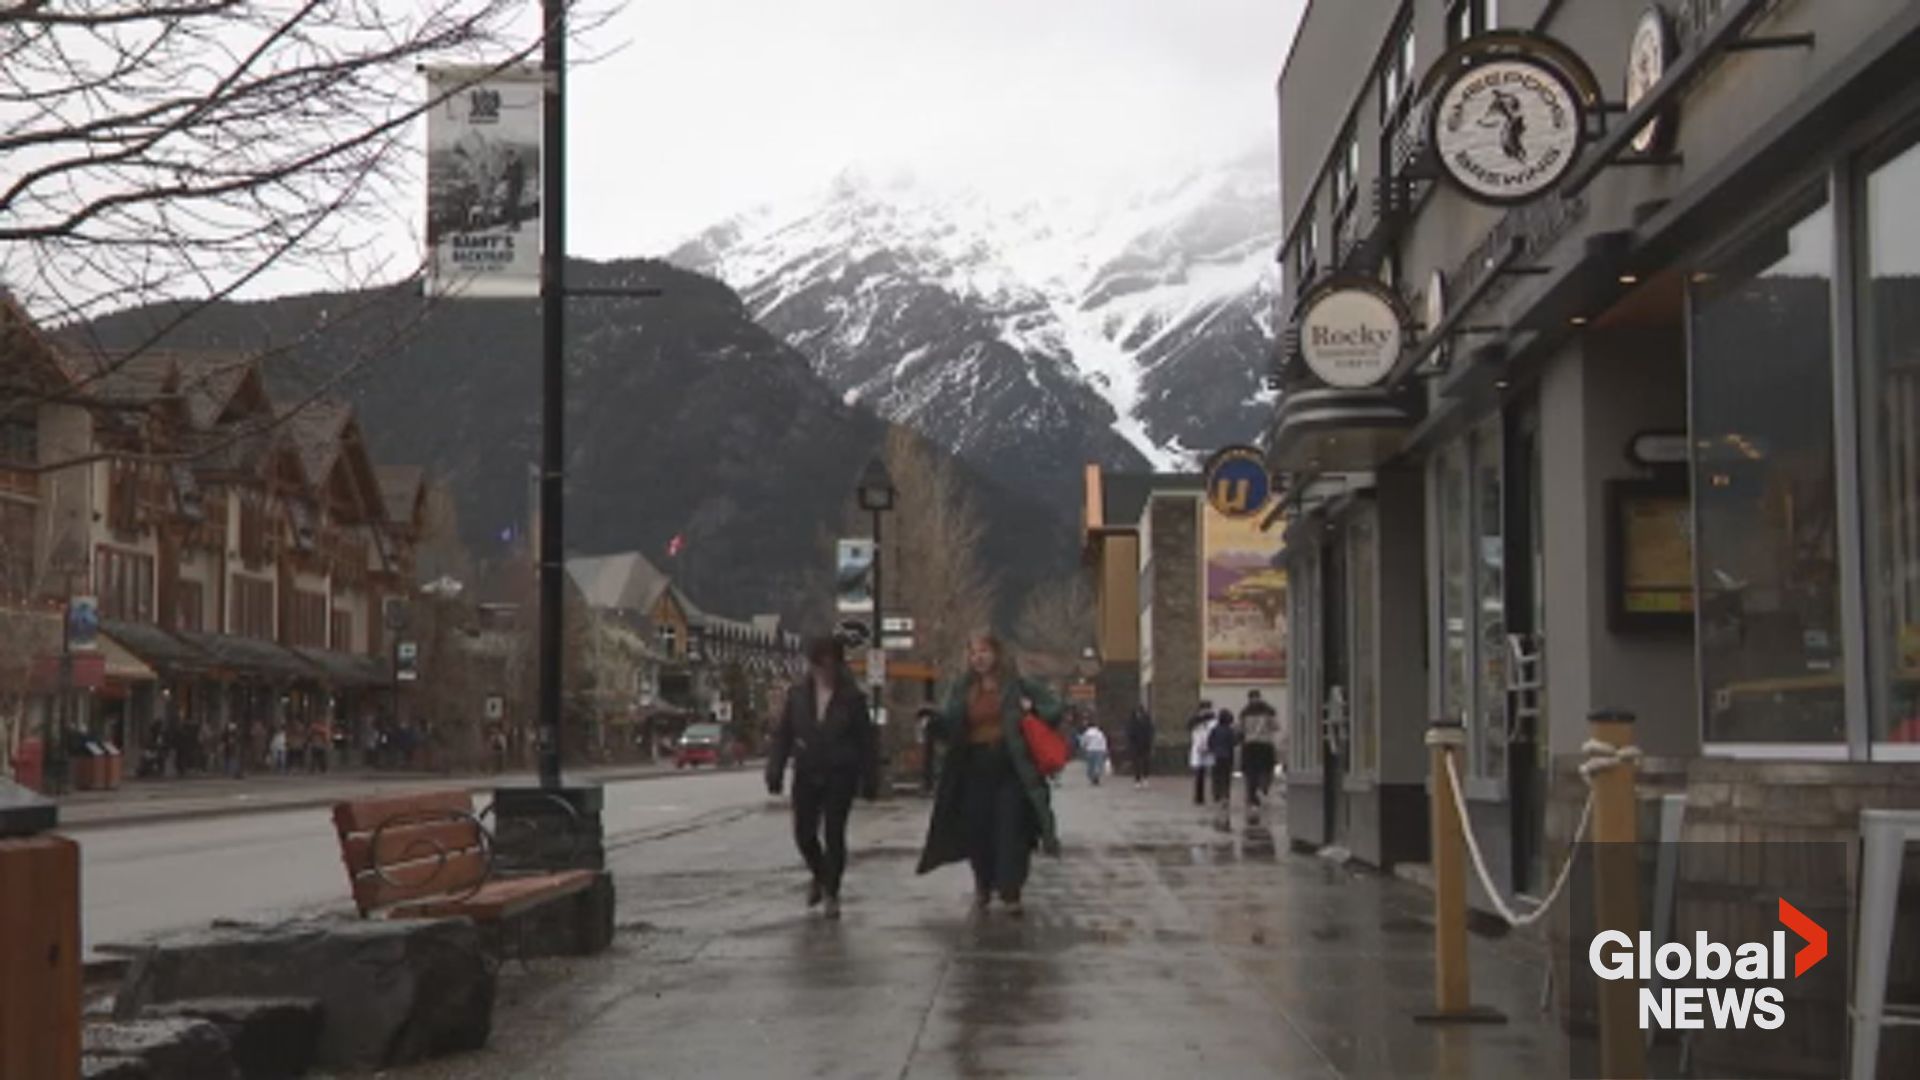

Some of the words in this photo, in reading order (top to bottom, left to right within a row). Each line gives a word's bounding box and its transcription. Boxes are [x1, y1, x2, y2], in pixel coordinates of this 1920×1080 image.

[1446, 70, 1565, 133] SHEEPDOG
[1455, 148, 1561, 186] BREWING
[1311, 322, 1392, 349] Rocky
